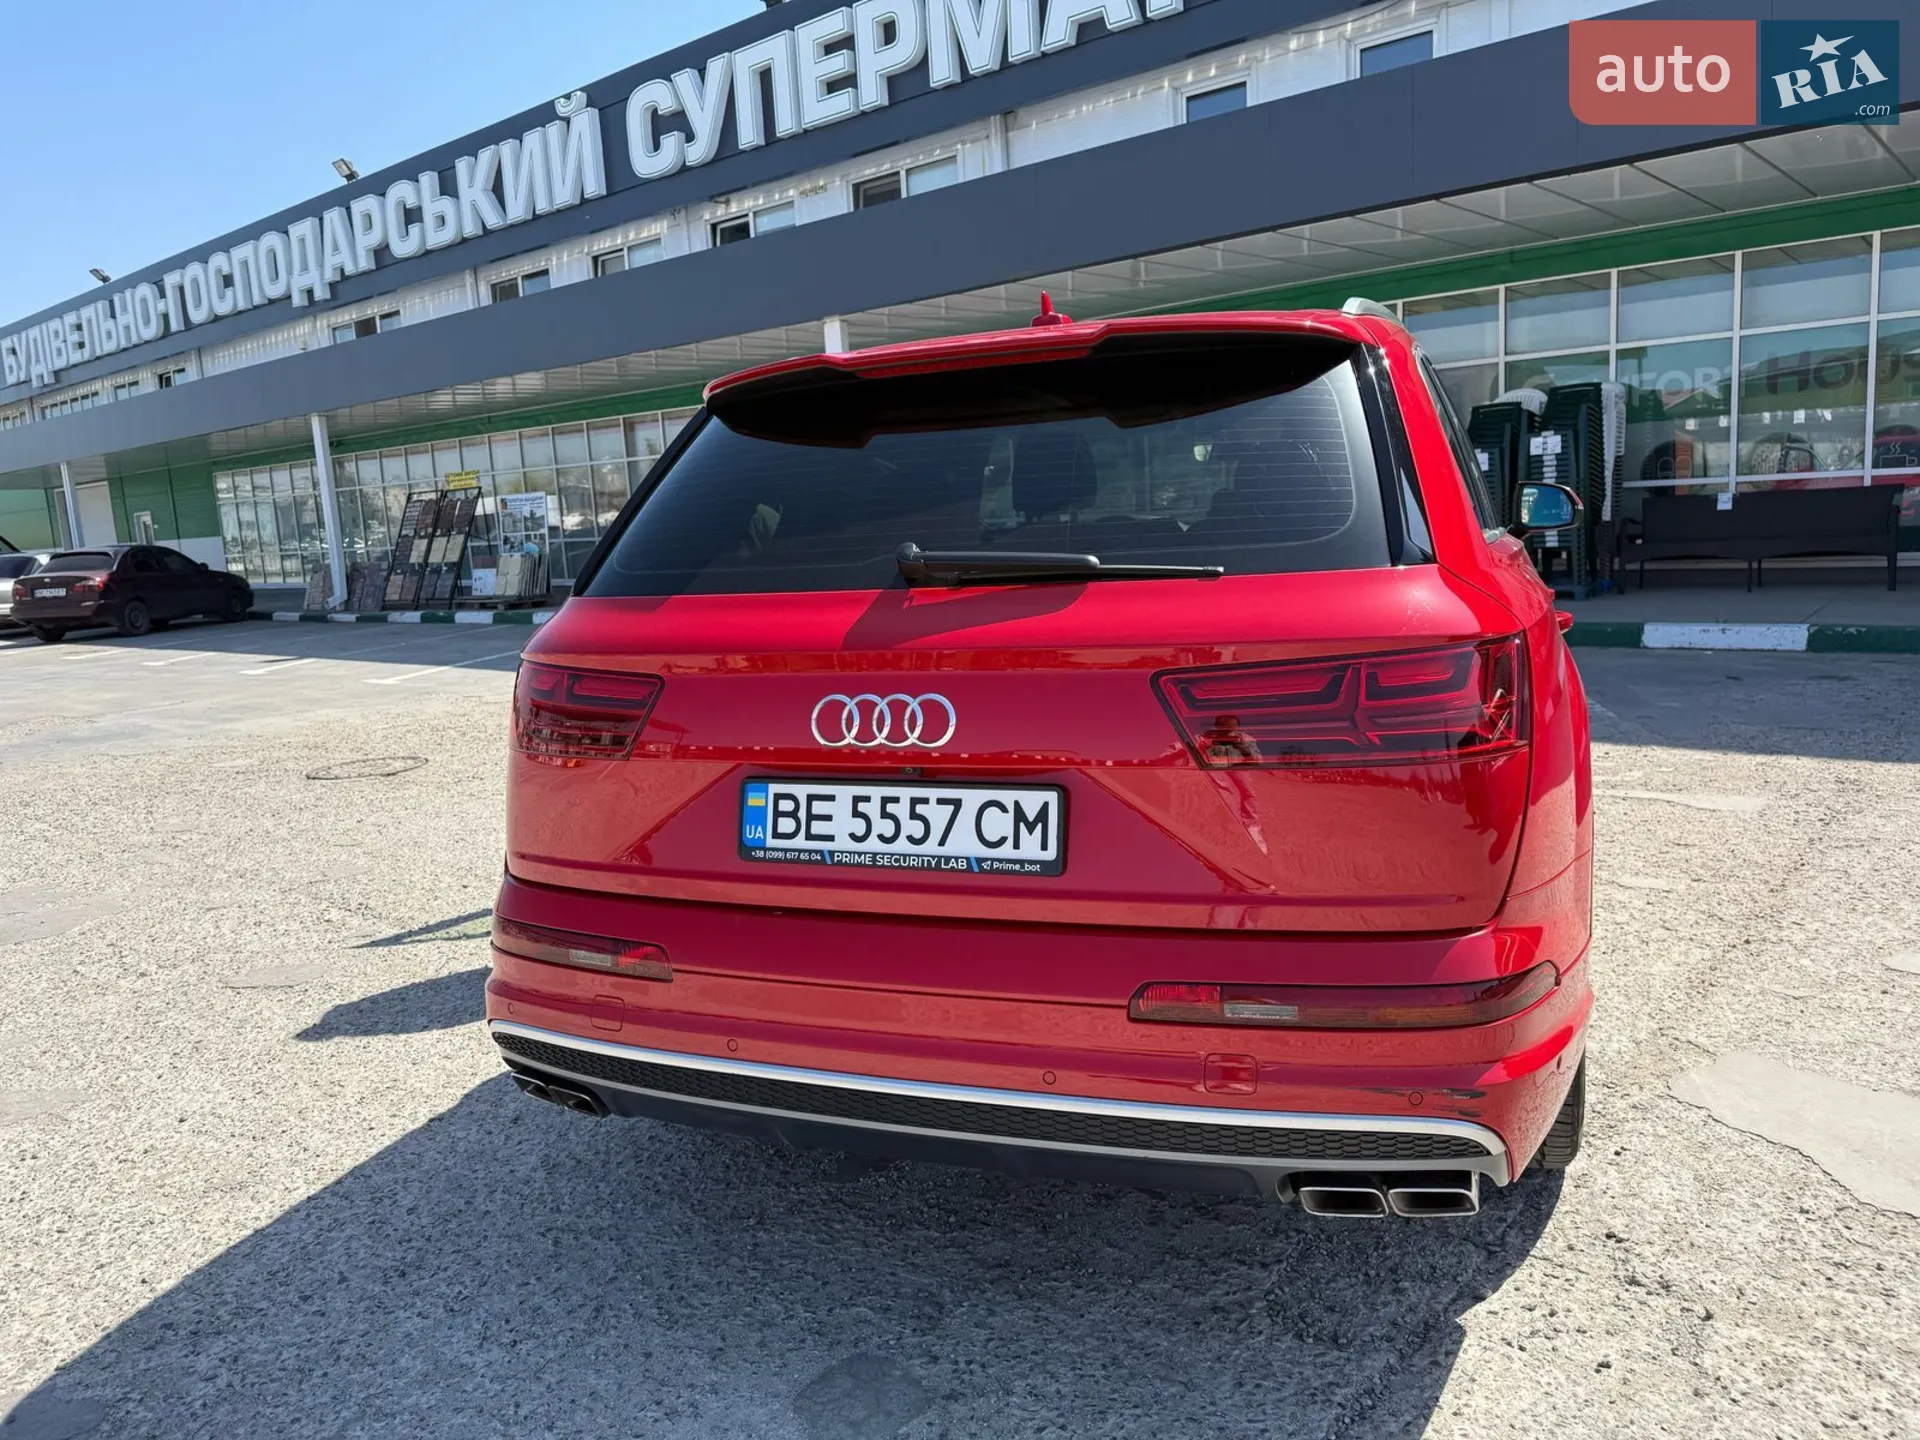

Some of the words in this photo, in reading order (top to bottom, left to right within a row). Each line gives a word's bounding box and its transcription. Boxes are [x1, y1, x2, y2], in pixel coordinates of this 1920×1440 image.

[2, 91, 607, 389] БУДІВЕЛЬНО-ГОСПОДАРСЬКИЙ
[626, 0, 1184, 179] СУПЕРМ
[746, 825, 764, 840] UA
[771, 792, 836, 842] BE
[847, 795, 963, 848] 5557
[975, 799, 1050, 852] CM
[786, 851, 799, 859] 617
[800, 852, 809, 860] 65
[834, 852, 874, 865] PRIME
[876, 854, 939, 868] SECURITY
[941, 857, 967, 869] LAB
[993, 861, 1041, 872] Prime_bot
